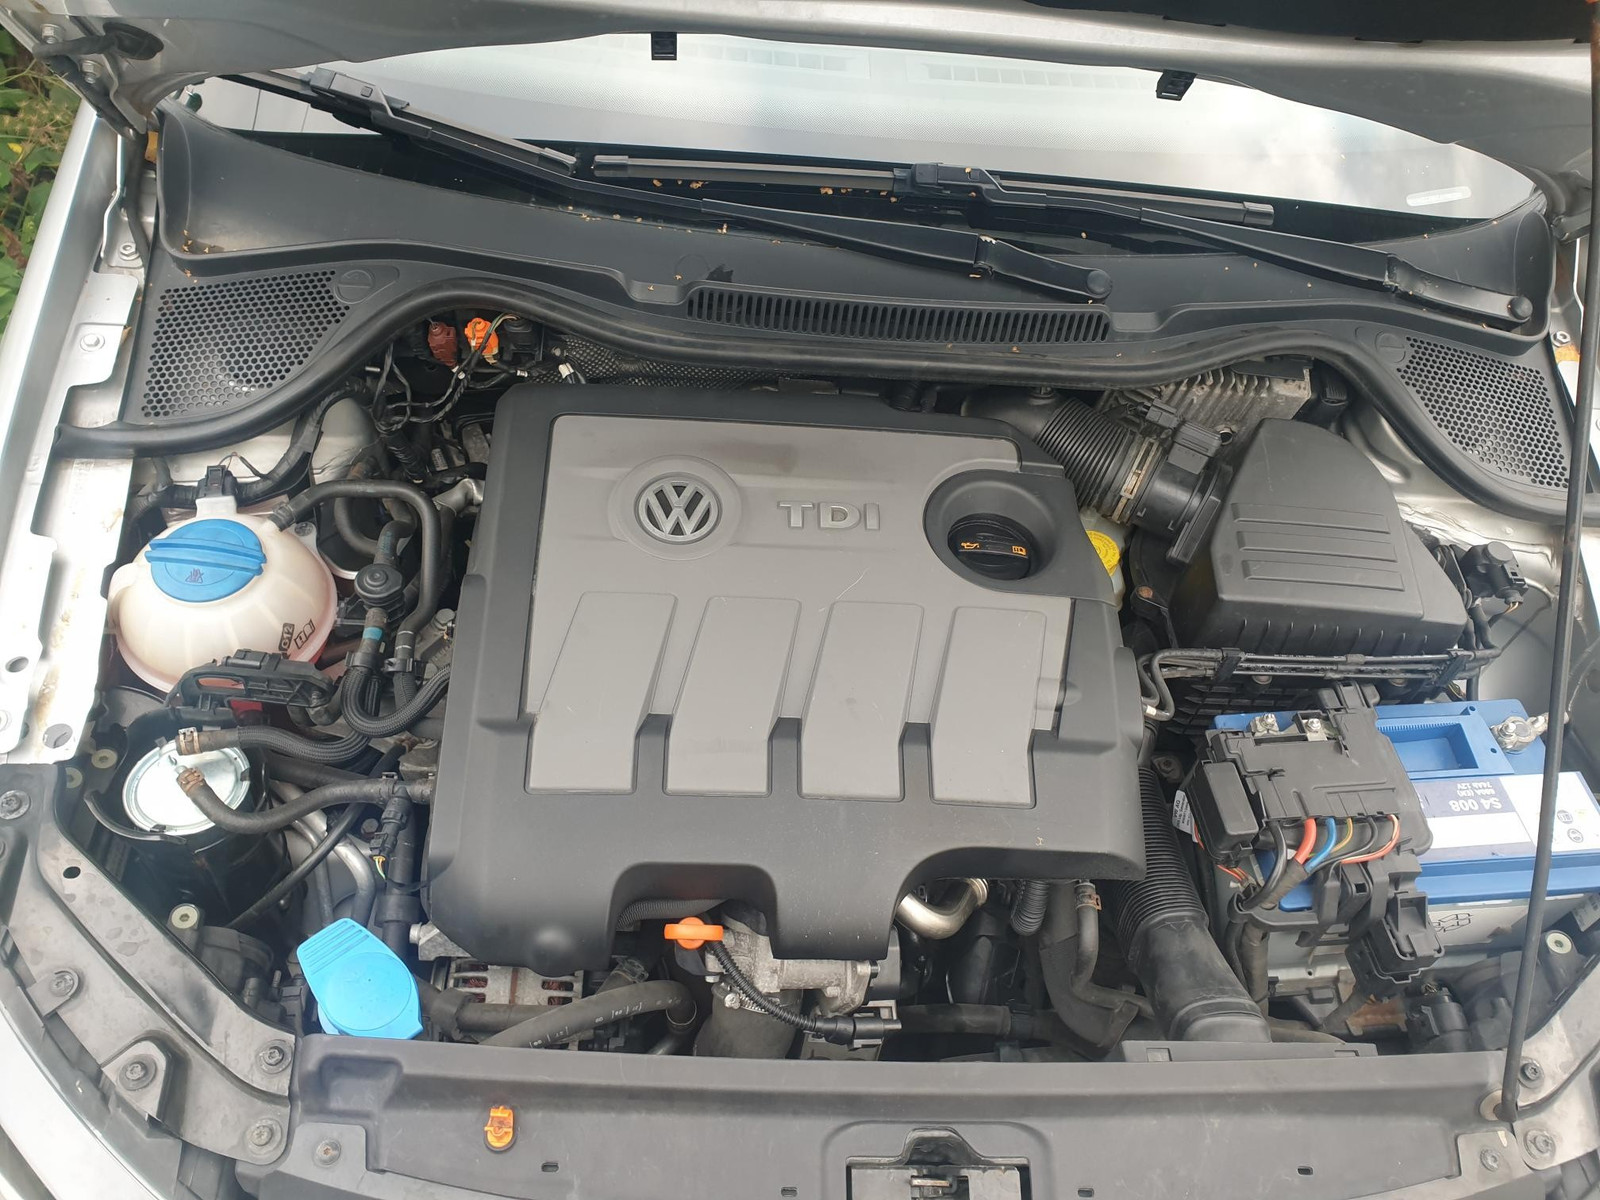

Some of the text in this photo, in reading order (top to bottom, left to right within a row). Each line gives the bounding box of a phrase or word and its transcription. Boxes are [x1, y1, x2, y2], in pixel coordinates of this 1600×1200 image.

[778, 501, 880, 530] TDI
[281, 624, 293, 650] G12
[1448, 799, 1479, 812] 008
